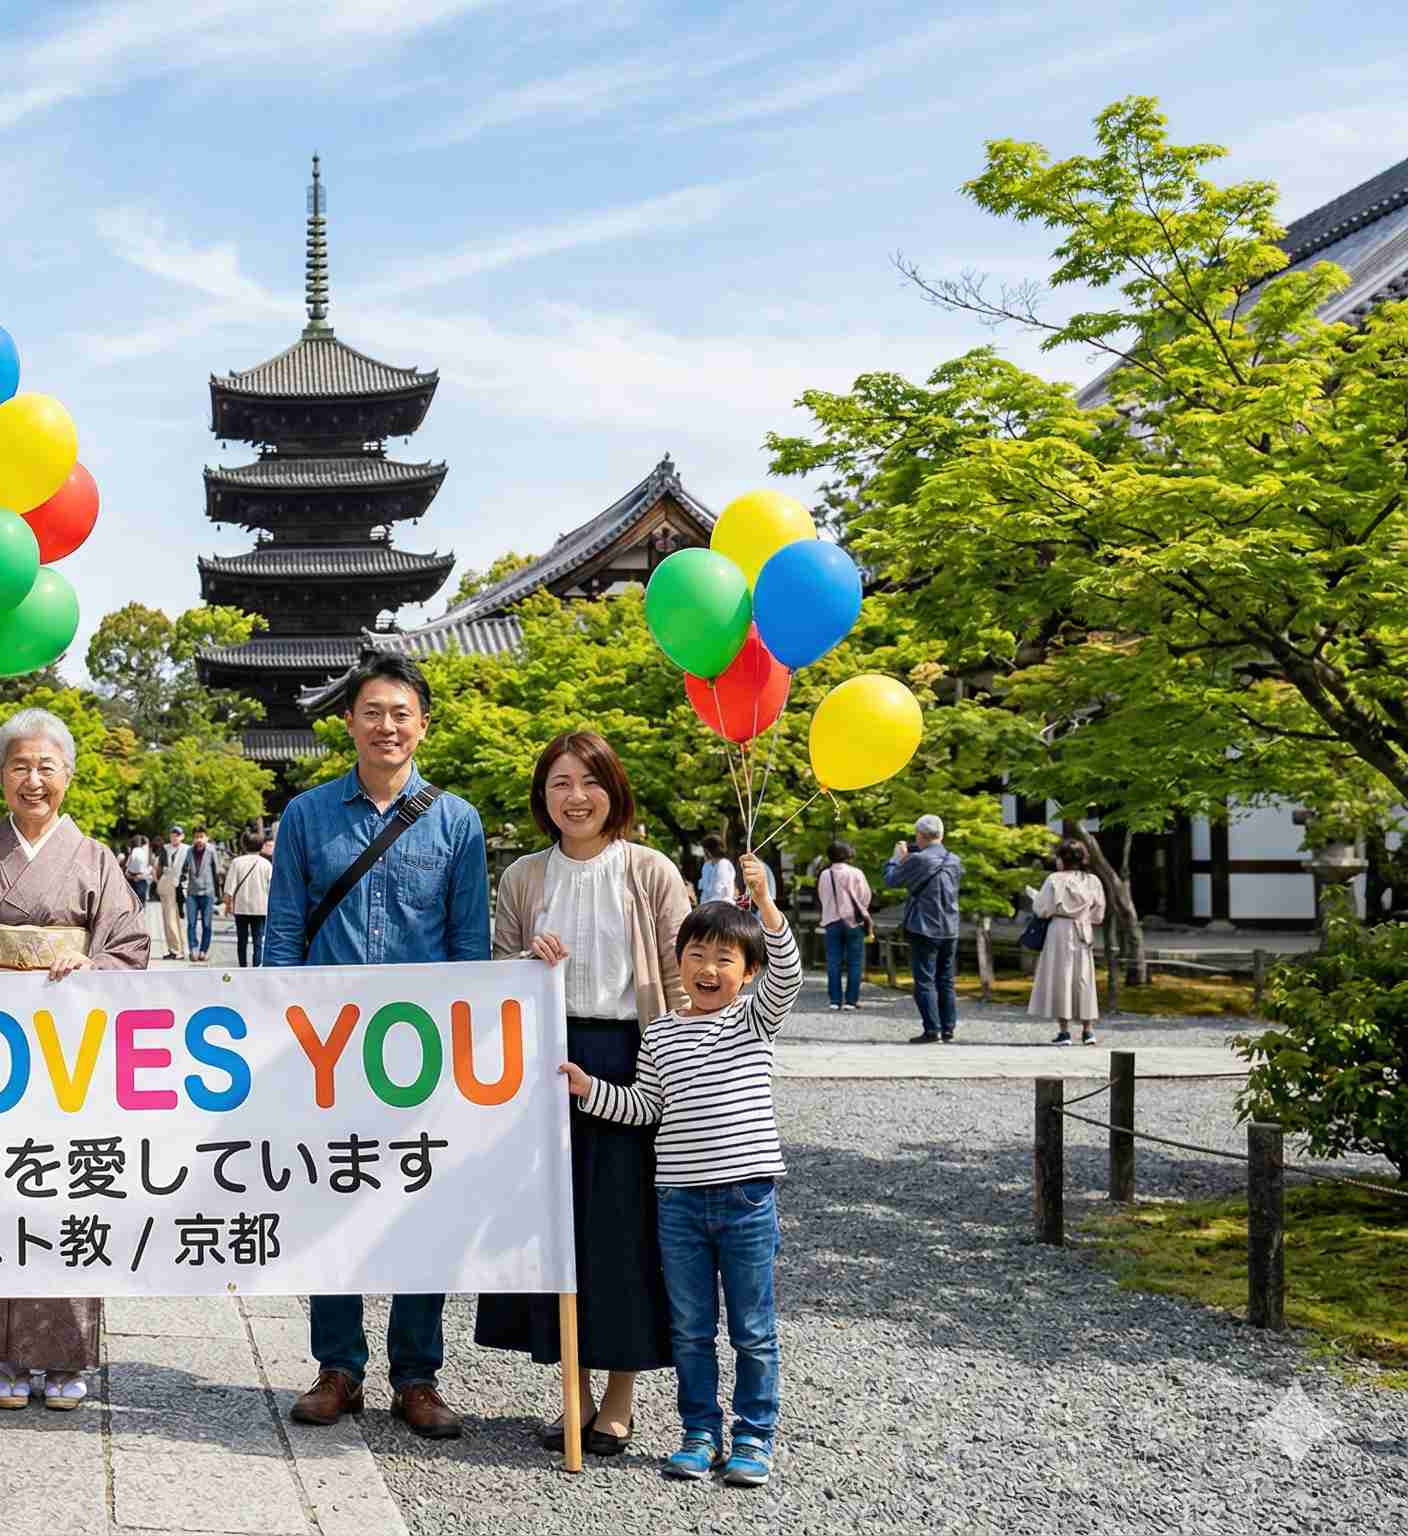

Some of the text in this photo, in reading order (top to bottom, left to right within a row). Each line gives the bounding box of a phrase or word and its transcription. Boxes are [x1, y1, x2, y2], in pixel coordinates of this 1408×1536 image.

[286, 999, 524, 1109] YOU
[130, 1216, 154, 1272] /
[174, 1211, 281, 1266] 京都
